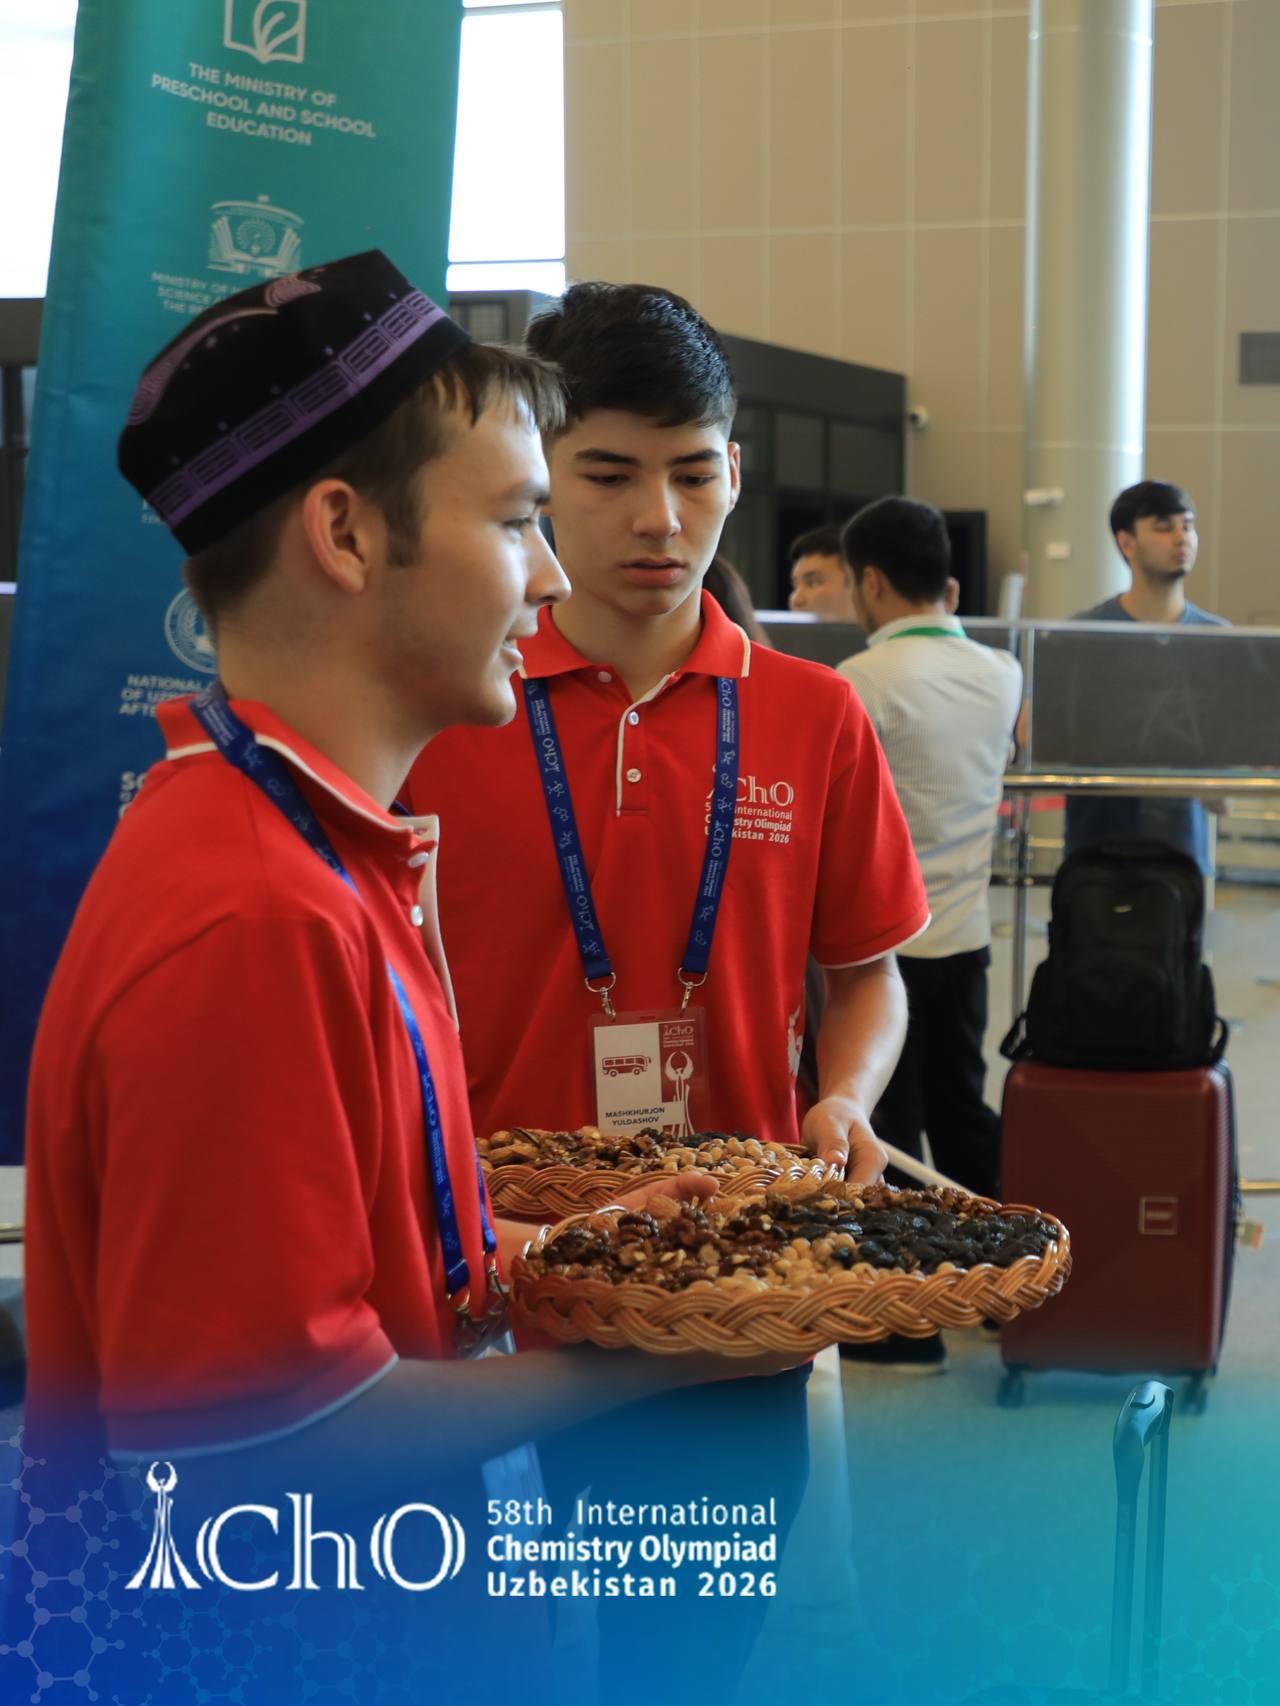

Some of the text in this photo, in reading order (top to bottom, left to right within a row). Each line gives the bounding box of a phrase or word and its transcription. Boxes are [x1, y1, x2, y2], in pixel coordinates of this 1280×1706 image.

[188, 62, 337, 106] THE MINISTRY OF
[152, 73, 377, 138] PRESCHOOL AND SCHOOL
[206, 111, 312, 145] EDUCATION
[127, 673, 203, 691] NATIONAL
[121, 687, 144, 702] OF
[768, 832, 790, 844] 2026
[612, 1116, 660, 1126] YULDASHOV
